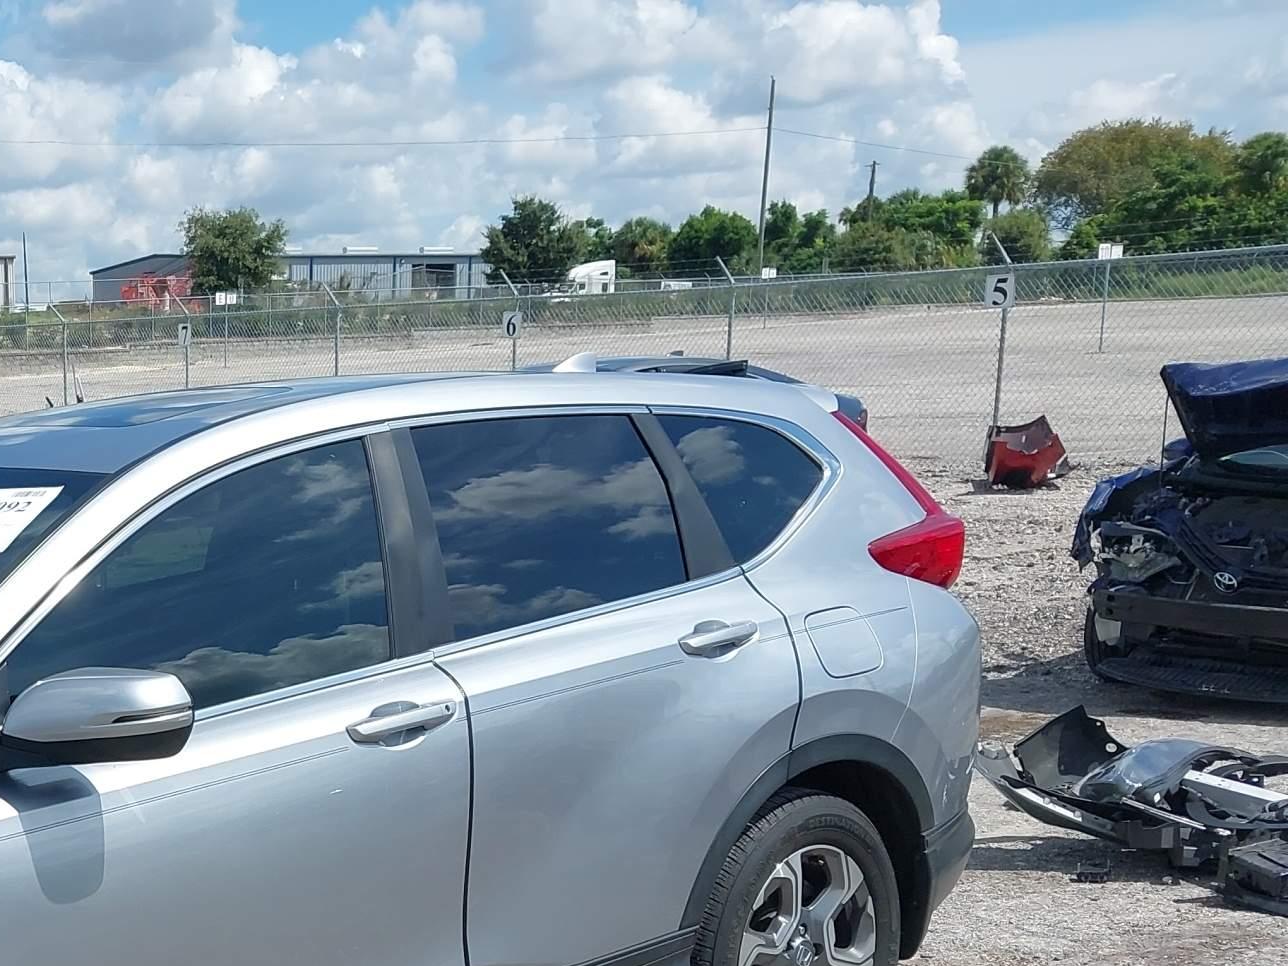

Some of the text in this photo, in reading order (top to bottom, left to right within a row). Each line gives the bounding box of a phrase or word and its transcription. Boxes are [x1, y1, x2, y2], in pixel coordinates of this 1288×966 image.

[992, 277, 1009, 305] 5
[182, 326, 188, 344] 7
[507, 314, 517, 336] 6
